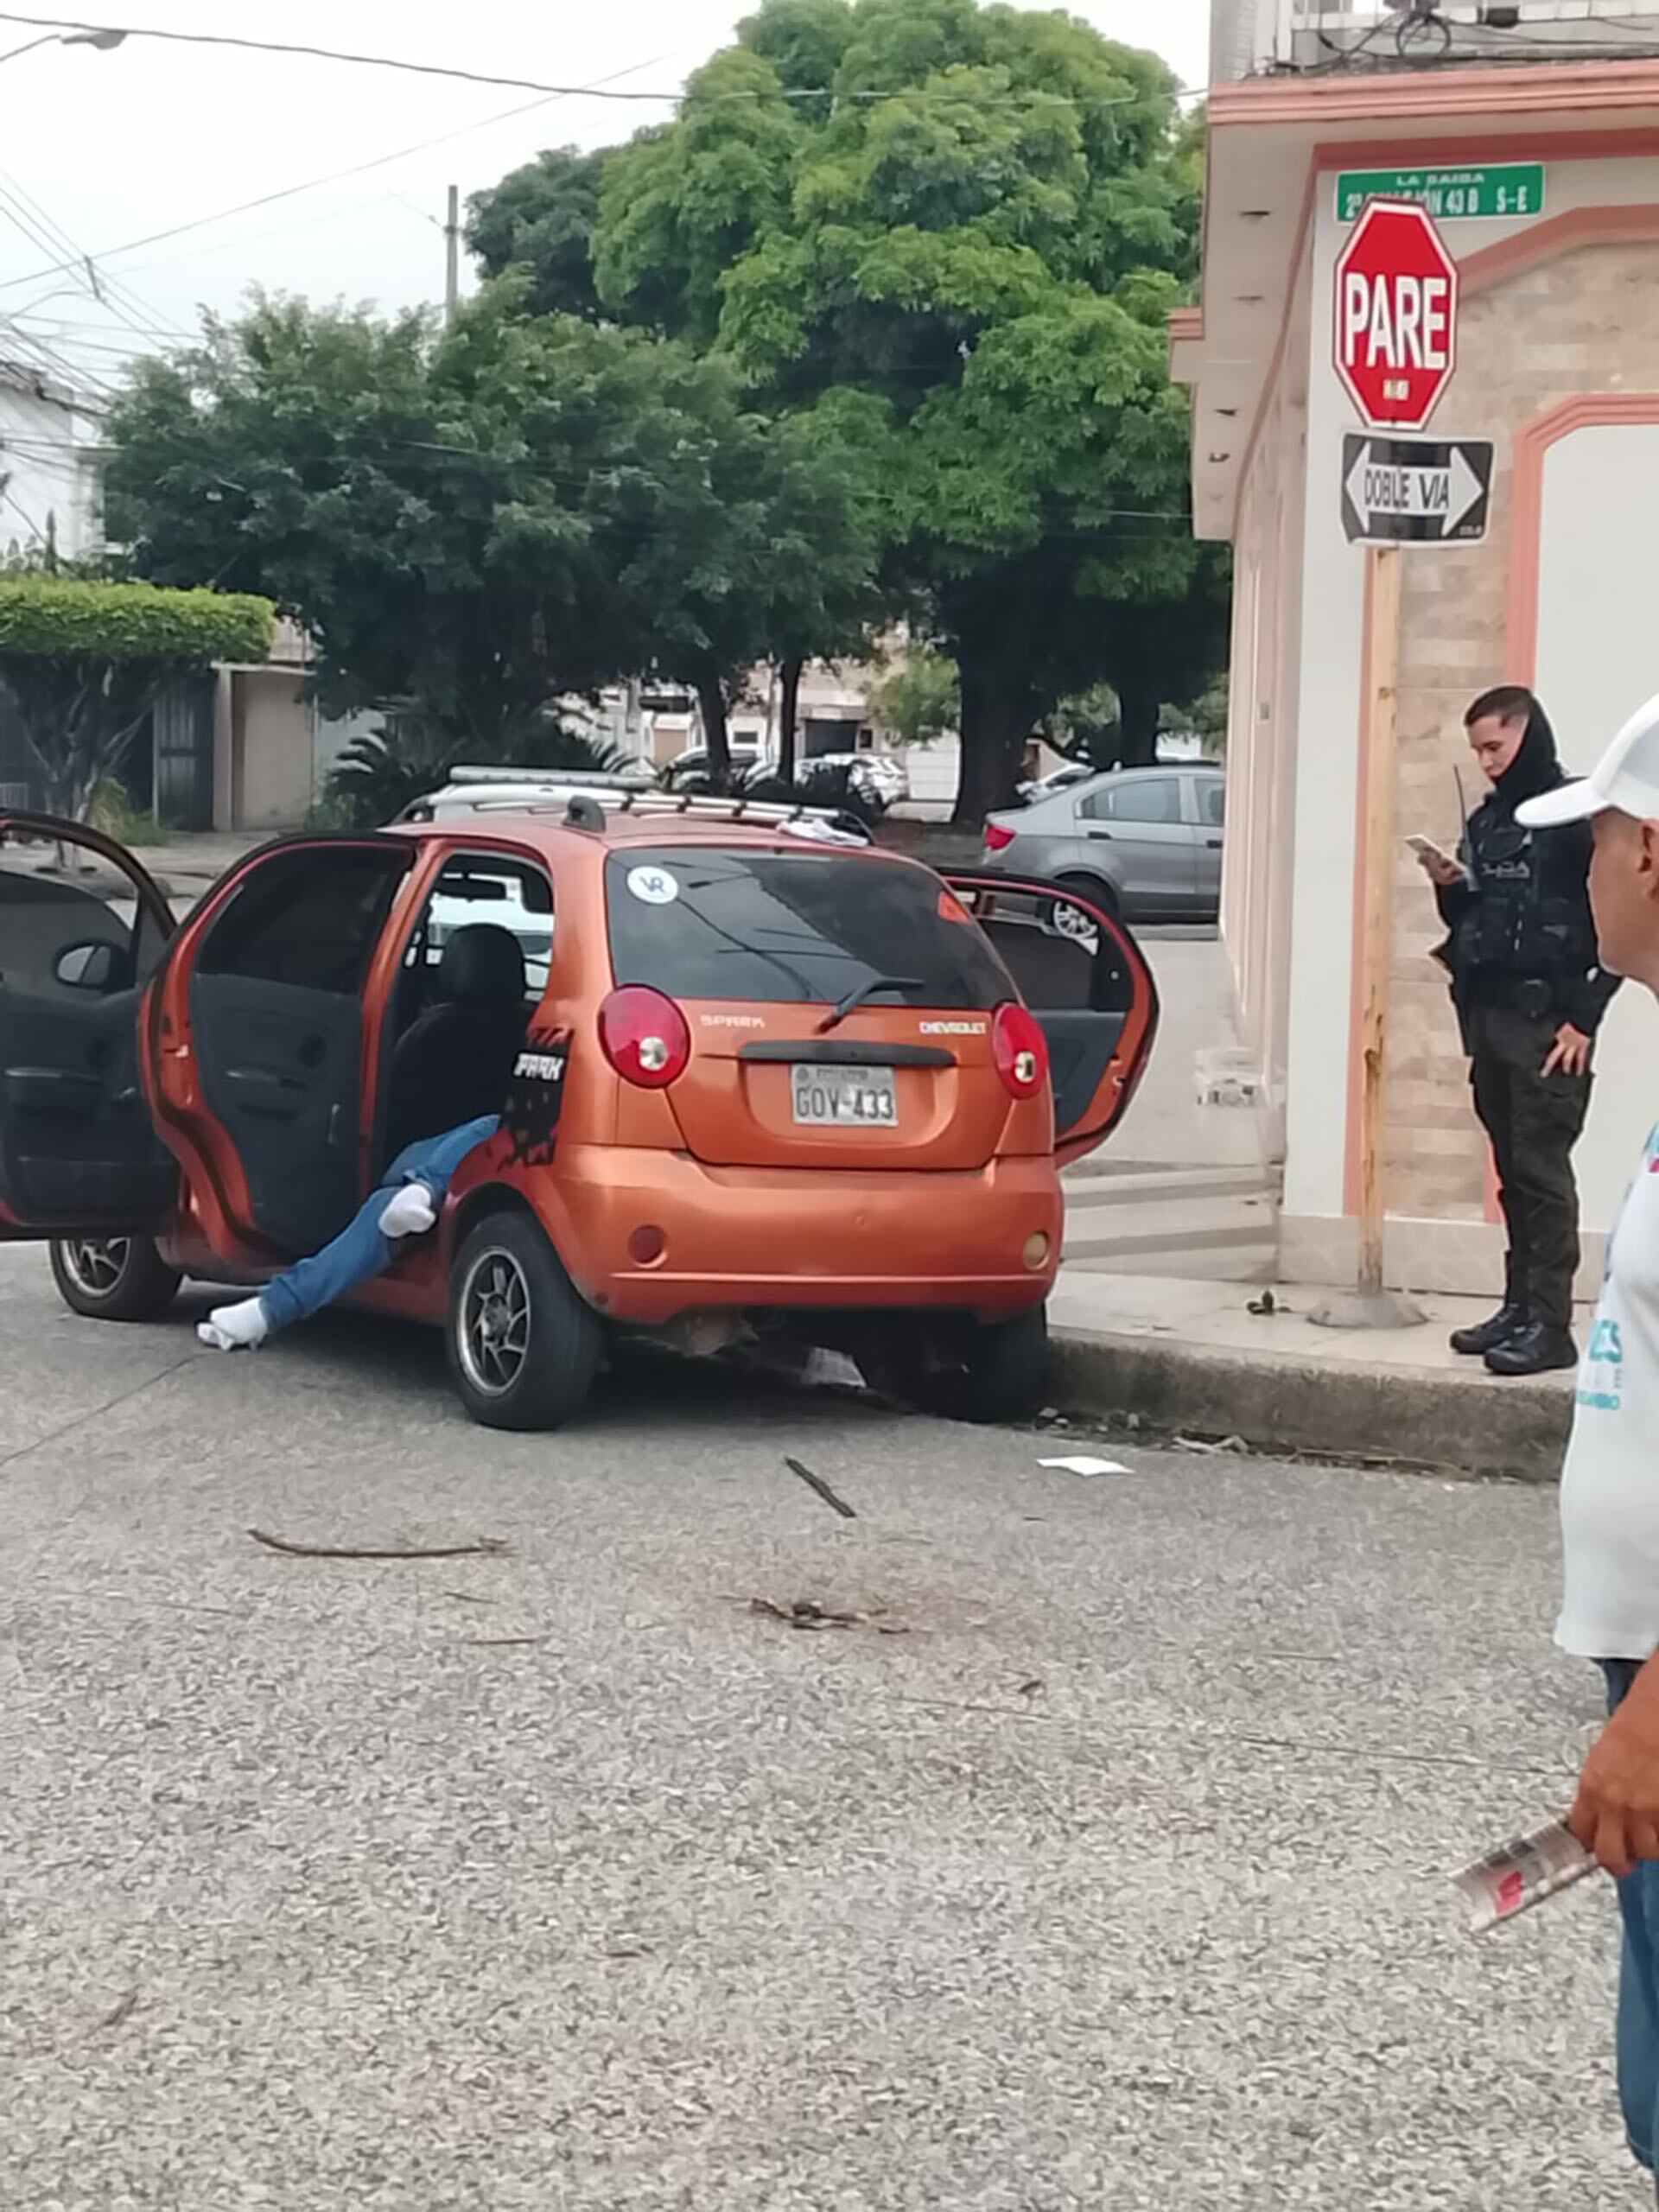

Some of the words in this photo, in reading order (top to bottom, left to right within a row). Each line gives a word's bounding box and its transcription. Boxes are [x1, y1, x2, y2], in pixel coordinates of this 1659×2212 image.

[1396, 175, 1420, 186] LA
[1496, 185, 1528, 213] S-E
[1345, 272, 1448, 371] PARE
[1364, 468, 1410, 508] DOBLE
[1418, 474, 1450, 509] VIA
[700, 1014, 766, 1028] SPARK
[796, 1087, 893, 1119] GOV-433
